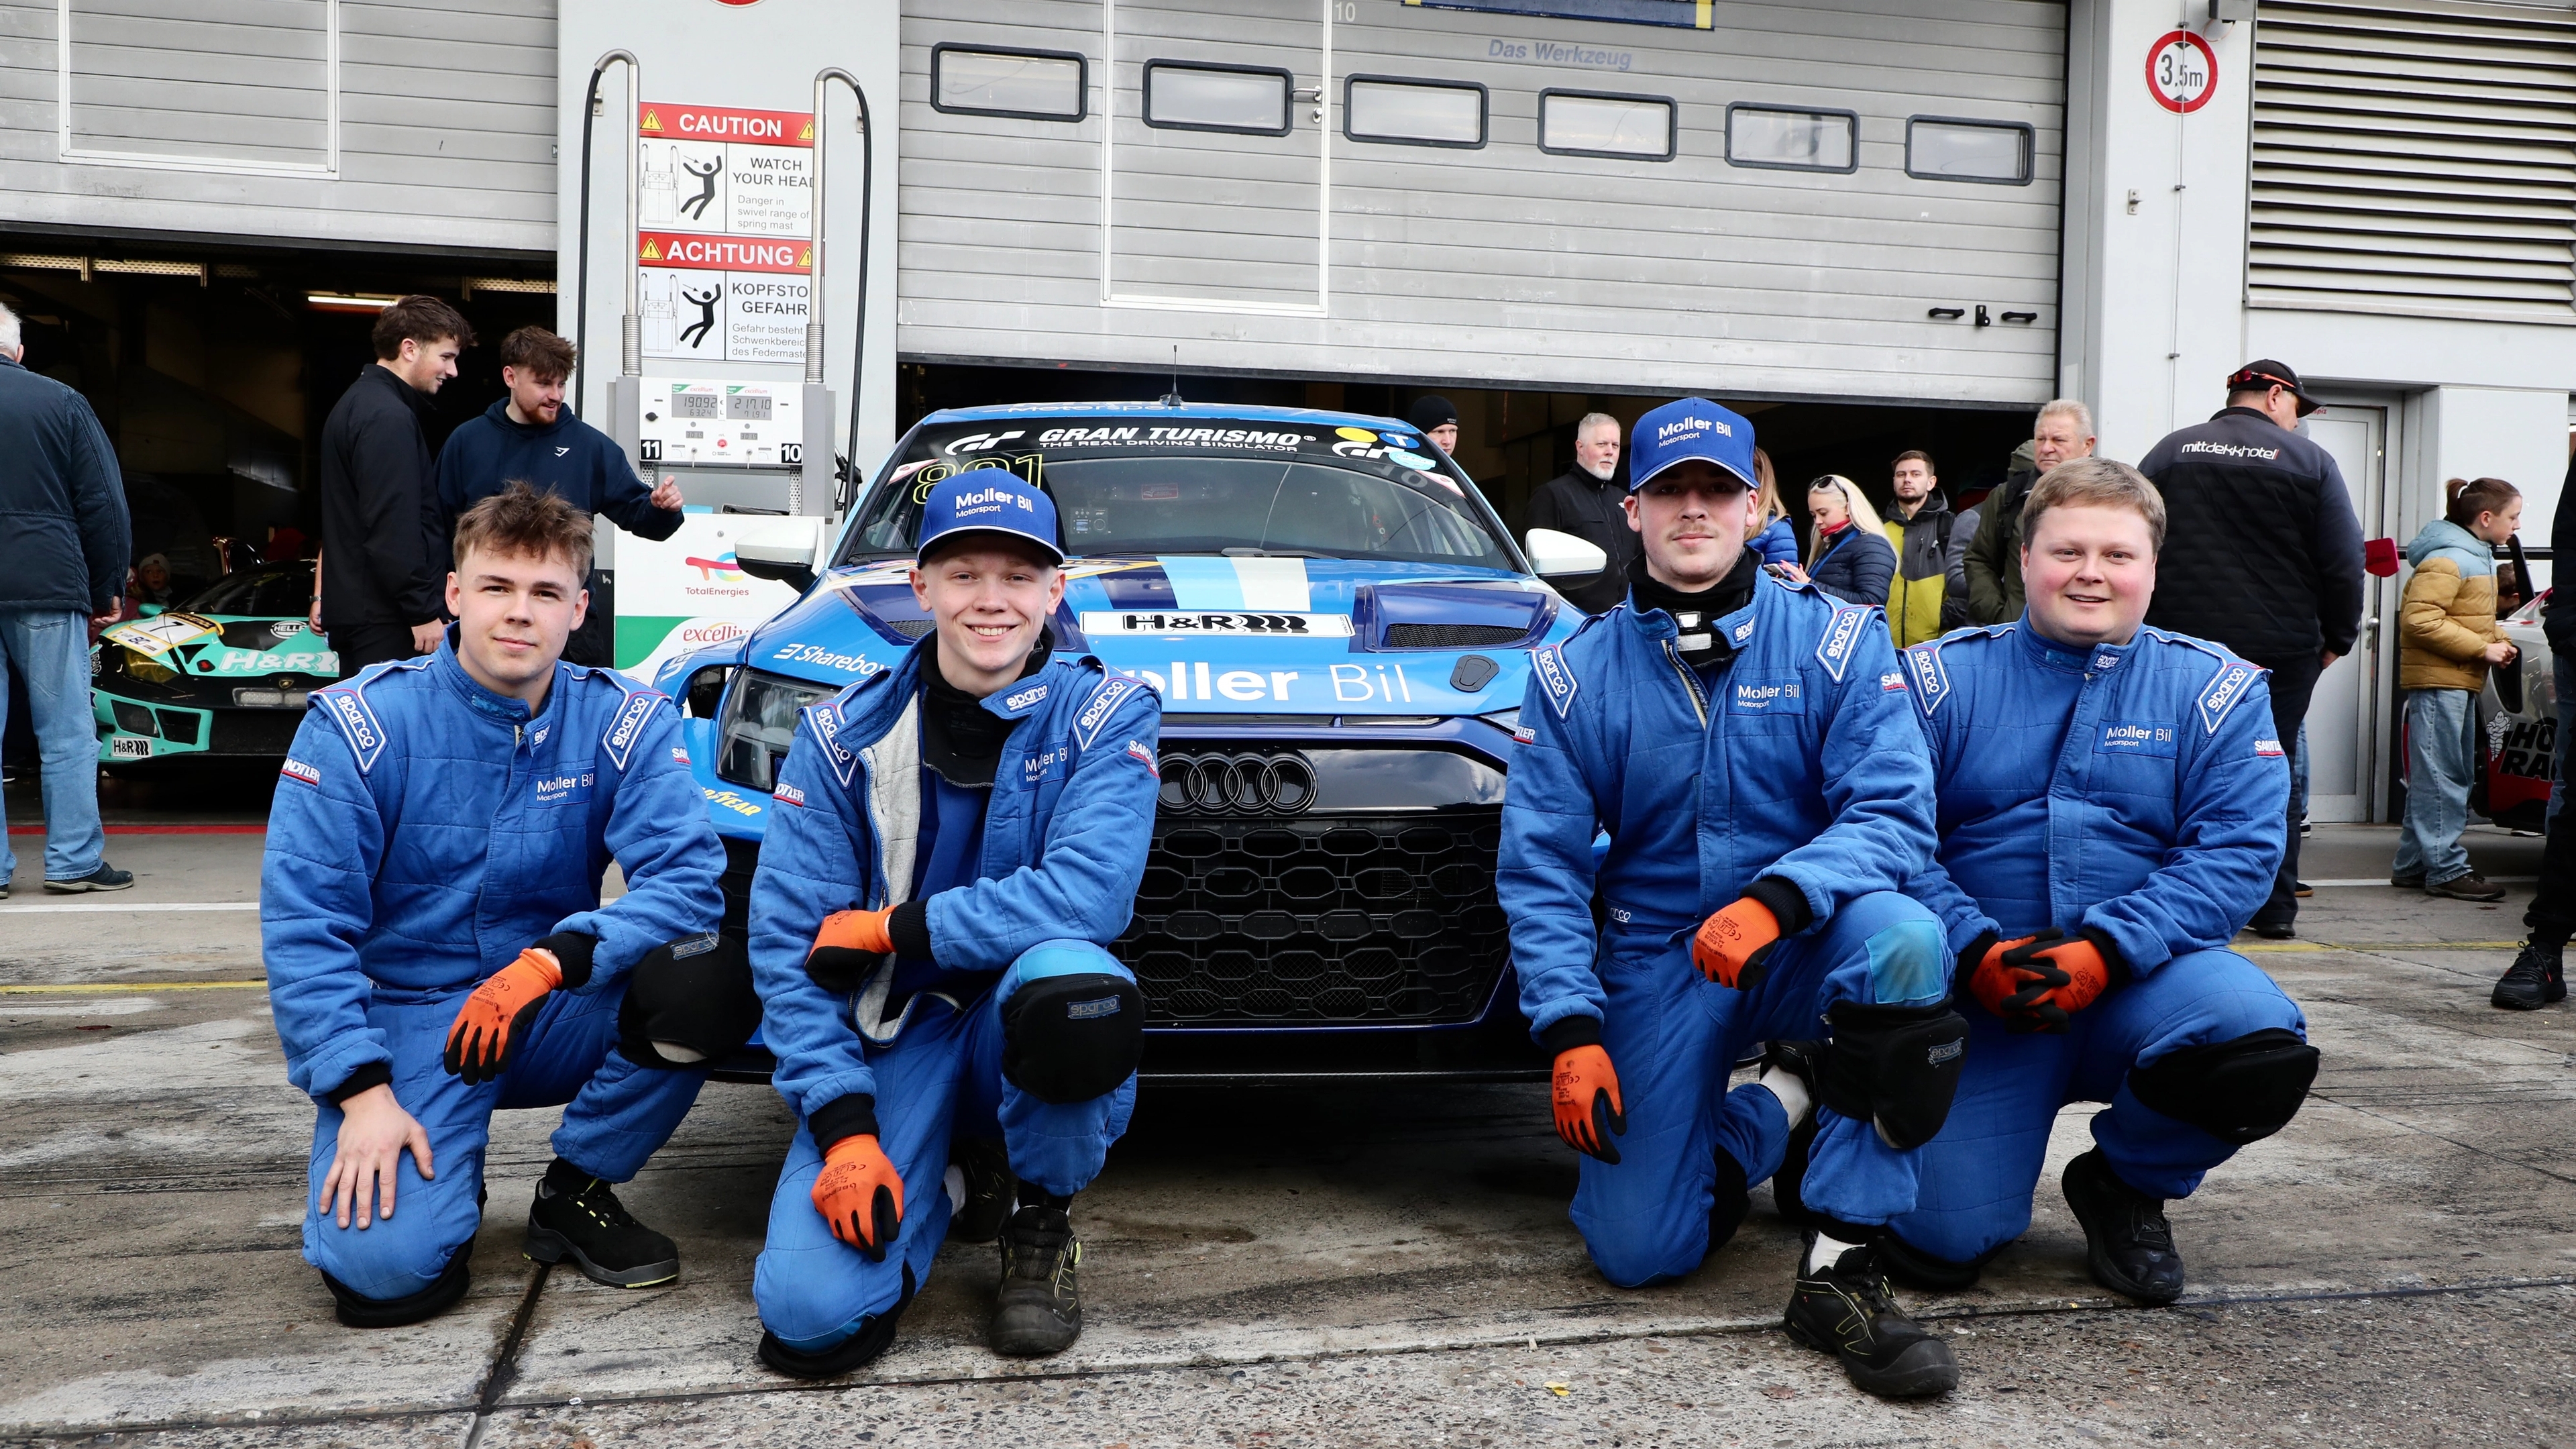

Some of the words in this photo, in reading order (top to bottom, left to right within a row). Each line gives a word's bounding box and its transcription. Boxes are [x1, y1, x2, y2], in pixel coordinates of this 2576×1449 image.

[1335, 3, 1356, 23] 10
[1489, 39, 1527, 59] Das
[1534, 42, 1632, 70] Werkzeug
[678, 113, 782, 138] CAUTION
[750, 157, 802, 171] WATCH
[733, 172, 773, 186] YOUR
[738, 195, 773, 207] Danger
[775, 197, 784, 205] in
[737, 208, 767, 216] swivel
[770, 210, 797, 220] range
[800, 211, 810, 219] of
[737, 219, 767, 230] spring
[770, 221, 794, 229] mast
[666, 241, 794, 267] ACHTUNG
[742, 301, 808, 315] GEFAHR
[732, 323, 766, 333] Gefahr
[768, 325, 803, 335] besteht
[732, 335, 807, 347] Schwenkbereic
[732, 347, 749, 356] des
[1008, 403, 1189, 413] Motorsport
[1038, 427, 1140, 443] GRAN
[1148, 427, 1301, 446] TURISMO
[1715, 421, 1732, 438] Bil
[1200, 441, 1298, 452] SIMULATOR
[1658, 431, 1700, 448] Motorsport
[642, 441, 660, 459] 11
[782, 444, 802, 462] 10
[955, 504, 1002, 519] Motorsport
[1017, 494, 1033, 513] Bil
[685, 587, 749, 597] TotalEnergies
[1124, 614, 1237, 630] H&R
[683, 625, 749, 642] excelli
[1826, 611, 1860, 659] sparco
[1539, 649, 1568, 698] sparco
[1914, 651, 1940, 695] sparco
[1328, 664, 1411, 703] Bil
[1784, 684, 1800, 699] Bil
[2206, 667, 2248, 713] sparco
[1006, 684, 1048, 711] sparco
[1080, 681, 1128, 731] sparco
[1737, 700, 1770, 710] Motorsport
[335, 695, 376, 749] sparco
[612, 697, 650, 749] sparco
[2155, 729, 2172, 743] Bil
[113, 739, 134, 753] H&R
[581, 773, 594, 788] Bil
[1070, 999, 1117, 1016] sparco
